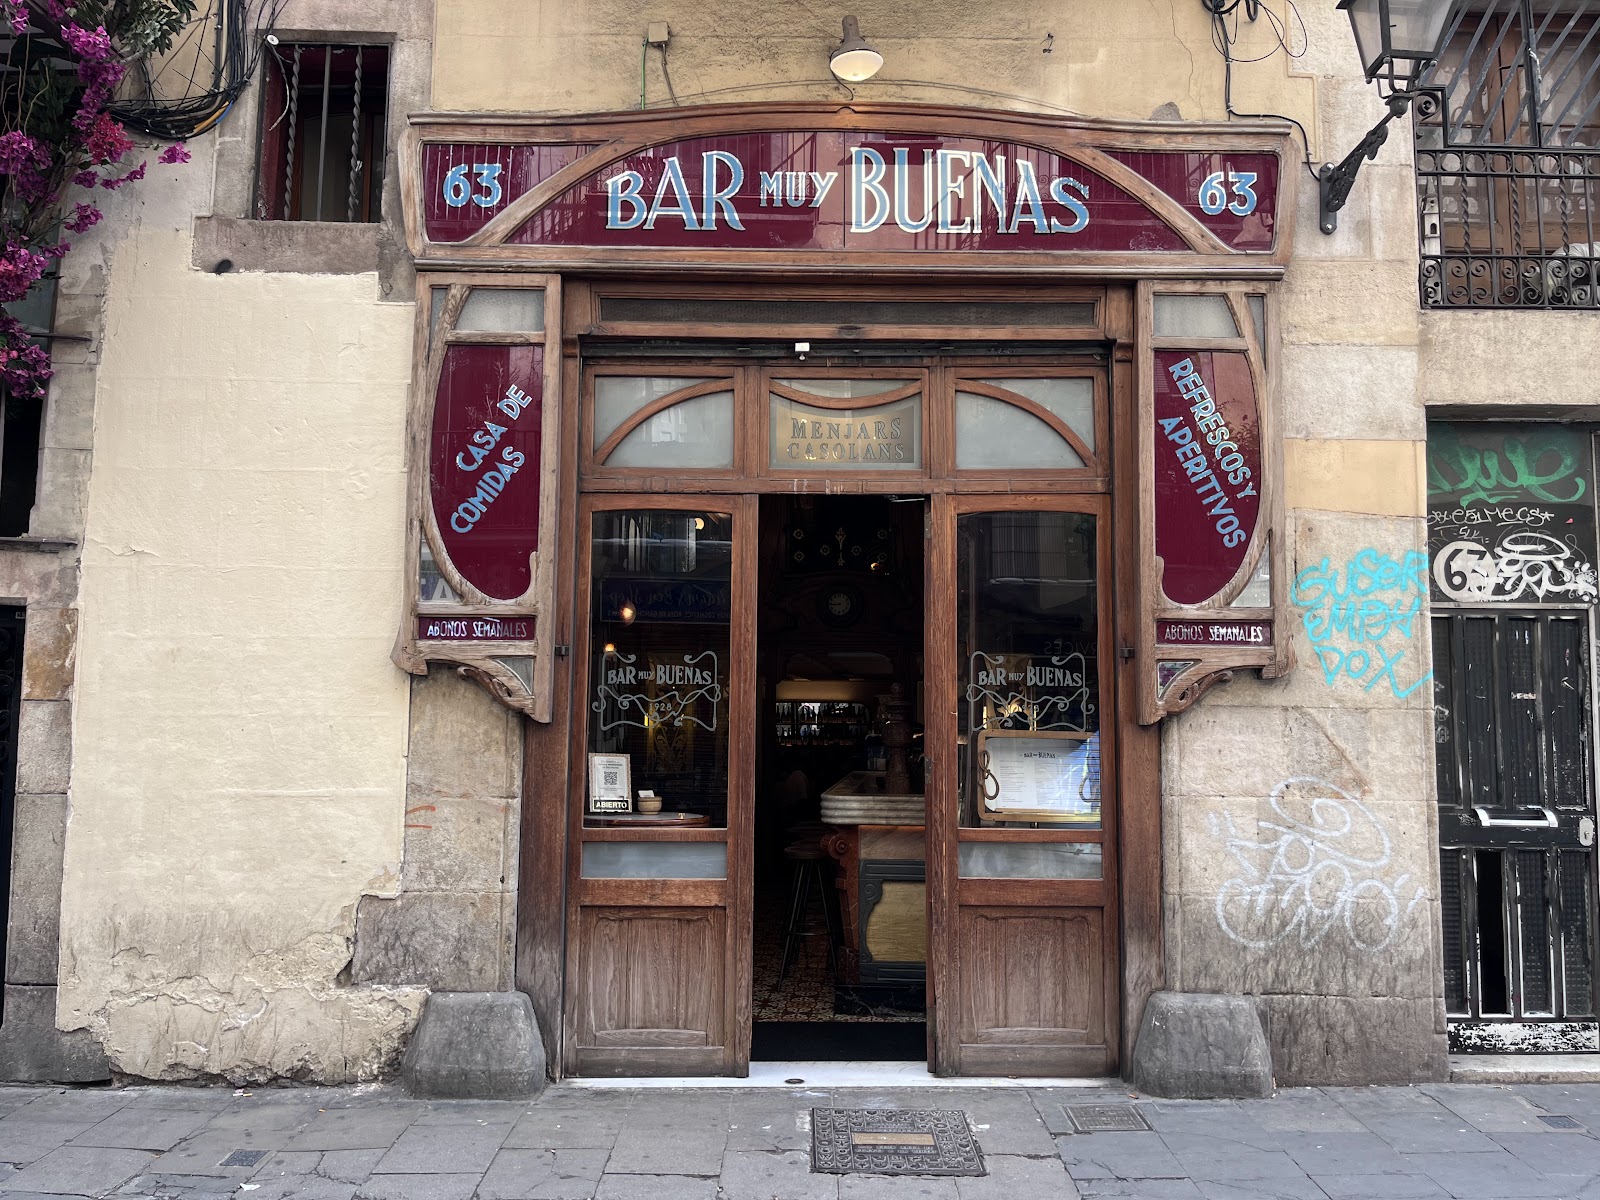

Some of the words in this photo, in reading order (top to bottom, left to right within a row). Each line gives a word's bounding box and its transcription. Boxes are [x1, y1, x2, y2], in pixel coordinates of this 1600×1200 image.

[442, 163, 503, 208] 63
[605, 150, 745, 233] BAR
[759, 170, 839, 208] MUY
[849, 147, 1091, 235] BUENAS
[1199, 170, 1258, 216] 63
[455, 420, 509, 472] CASA
[496, 383, 533, 421] DE
[790, 417, 901, 439] MENJARS
[1168, 357, 1252, 486] REFRESCOS
[1236, 482, 1257, 499] Y
[787, 442, 904, 460] CASOLANS
[450, 446, 526, 533] COMIDAS
[1158, 415, 1247, 548] APERITIVOS
[426, 620, 468, 638] ABONOS
[472, 620, 528, 638] SEMANALES
[1164, 624, 1204, 641] ABONOS
[1208, 625, 1263, 642] SEMANALES
[607, 665, 637, 685] BAR
[637, 670, 655, 680] MUY
[656, 664, 712, 685] BUENAS
[978, 667, 1007, 686] BAR
[1008, 672, 1025, 681] MUY
[1026, 665, 1082, 687] BUENAS
[649, 702, 672, 712] 1928
[596, 801, 627, 809] ABIERTO
